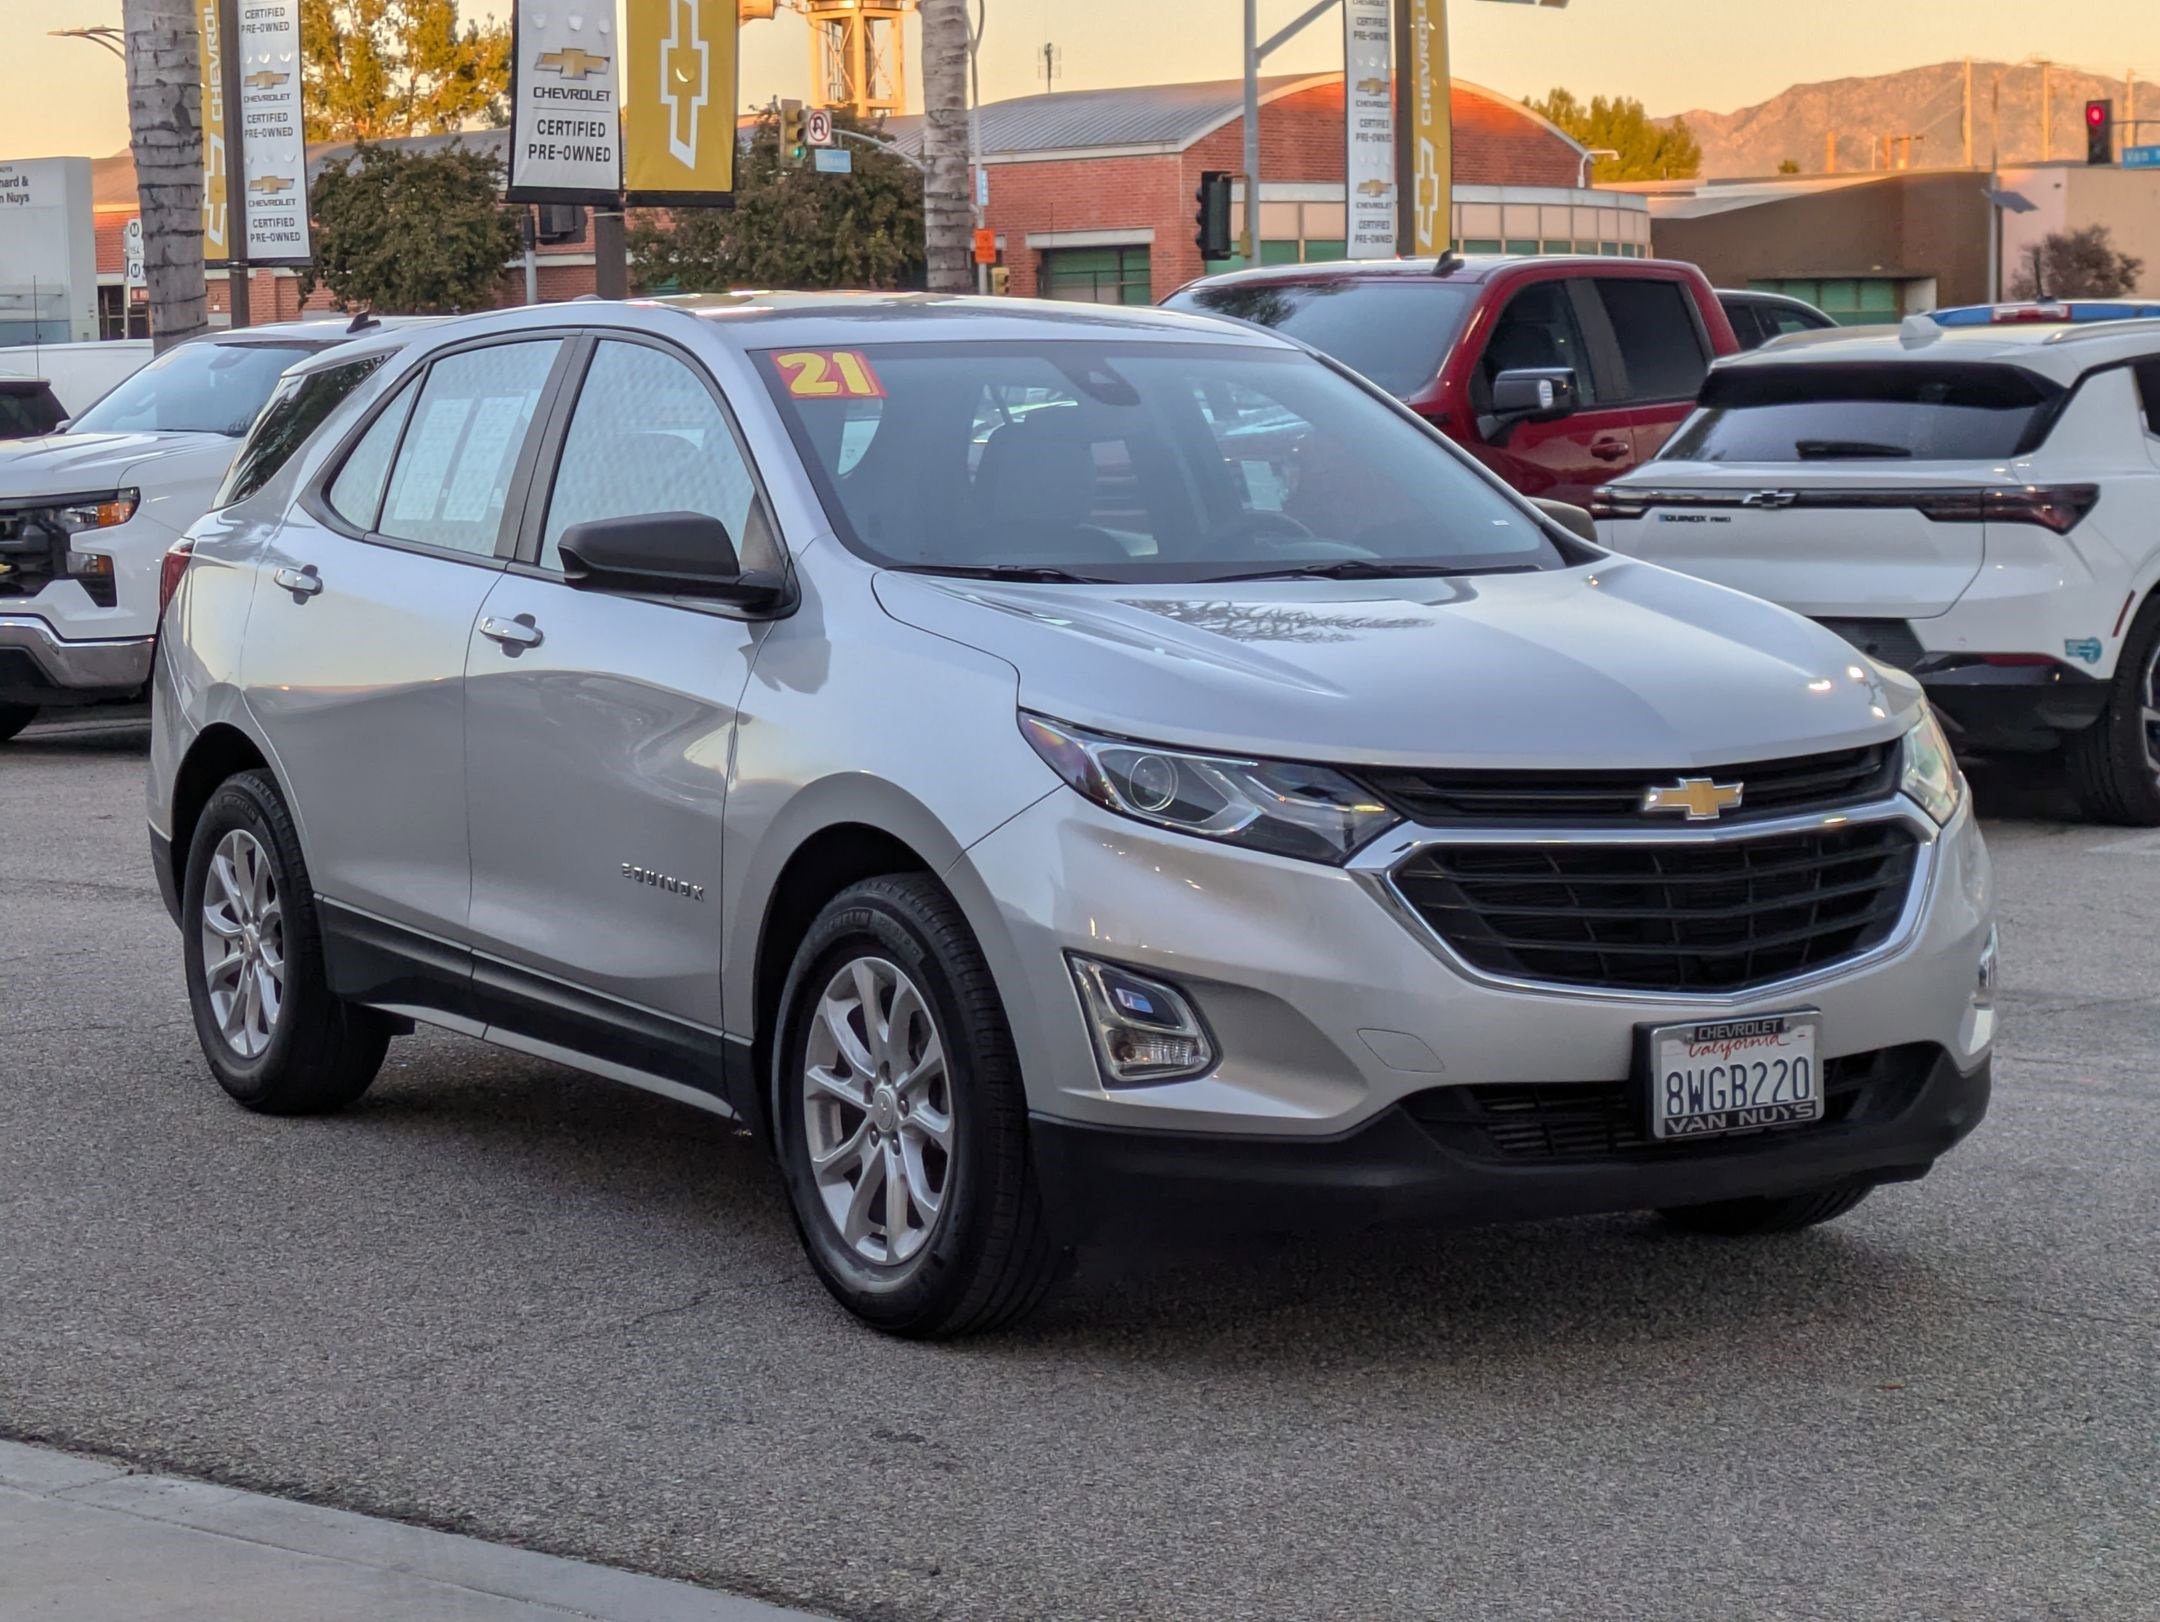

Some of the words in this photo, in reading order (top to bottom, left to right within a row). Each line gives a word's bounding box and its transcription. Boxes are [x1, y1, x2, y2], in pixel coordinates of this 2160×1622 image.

[245, 8, 285, 19] CERTIFIED
[241, 22, 289, 33] PRE-OWNED
[244, 94, 291, 103] CHEVROLET
[533, 87, 611, 102] CHEVROLET
[247, 113, 288, 124] CERTIFIED
[245, 127, 293, 138] PRE-OWNED
[537, 119, 606, 138] CERTIFIED
[528, 144, 611, 162] PRE-OWNED
[248, 199, 296, 207] CHEVROLET
[253, 218, 295, 228] CERTIFIED
[1359, 221, 1389, 229] CERTIFIED
[250, 232, 300, 242] PRE-OWNED
[1355, 235, 1392, 243] PRE-OWNED
[777, 352, 879, 395] 21
[622, 863, 704, 902] EQUINOX
[1699, 1020, 1780, 1040] CHEVROLET
[1689, 1034, 1790, 1060] California
[1666, 1056, 1810, 1116] 8WGB220
[1668, 1114, 1726, 1134] VAN
[1737, 1102, 1814, 1127] NUYS
